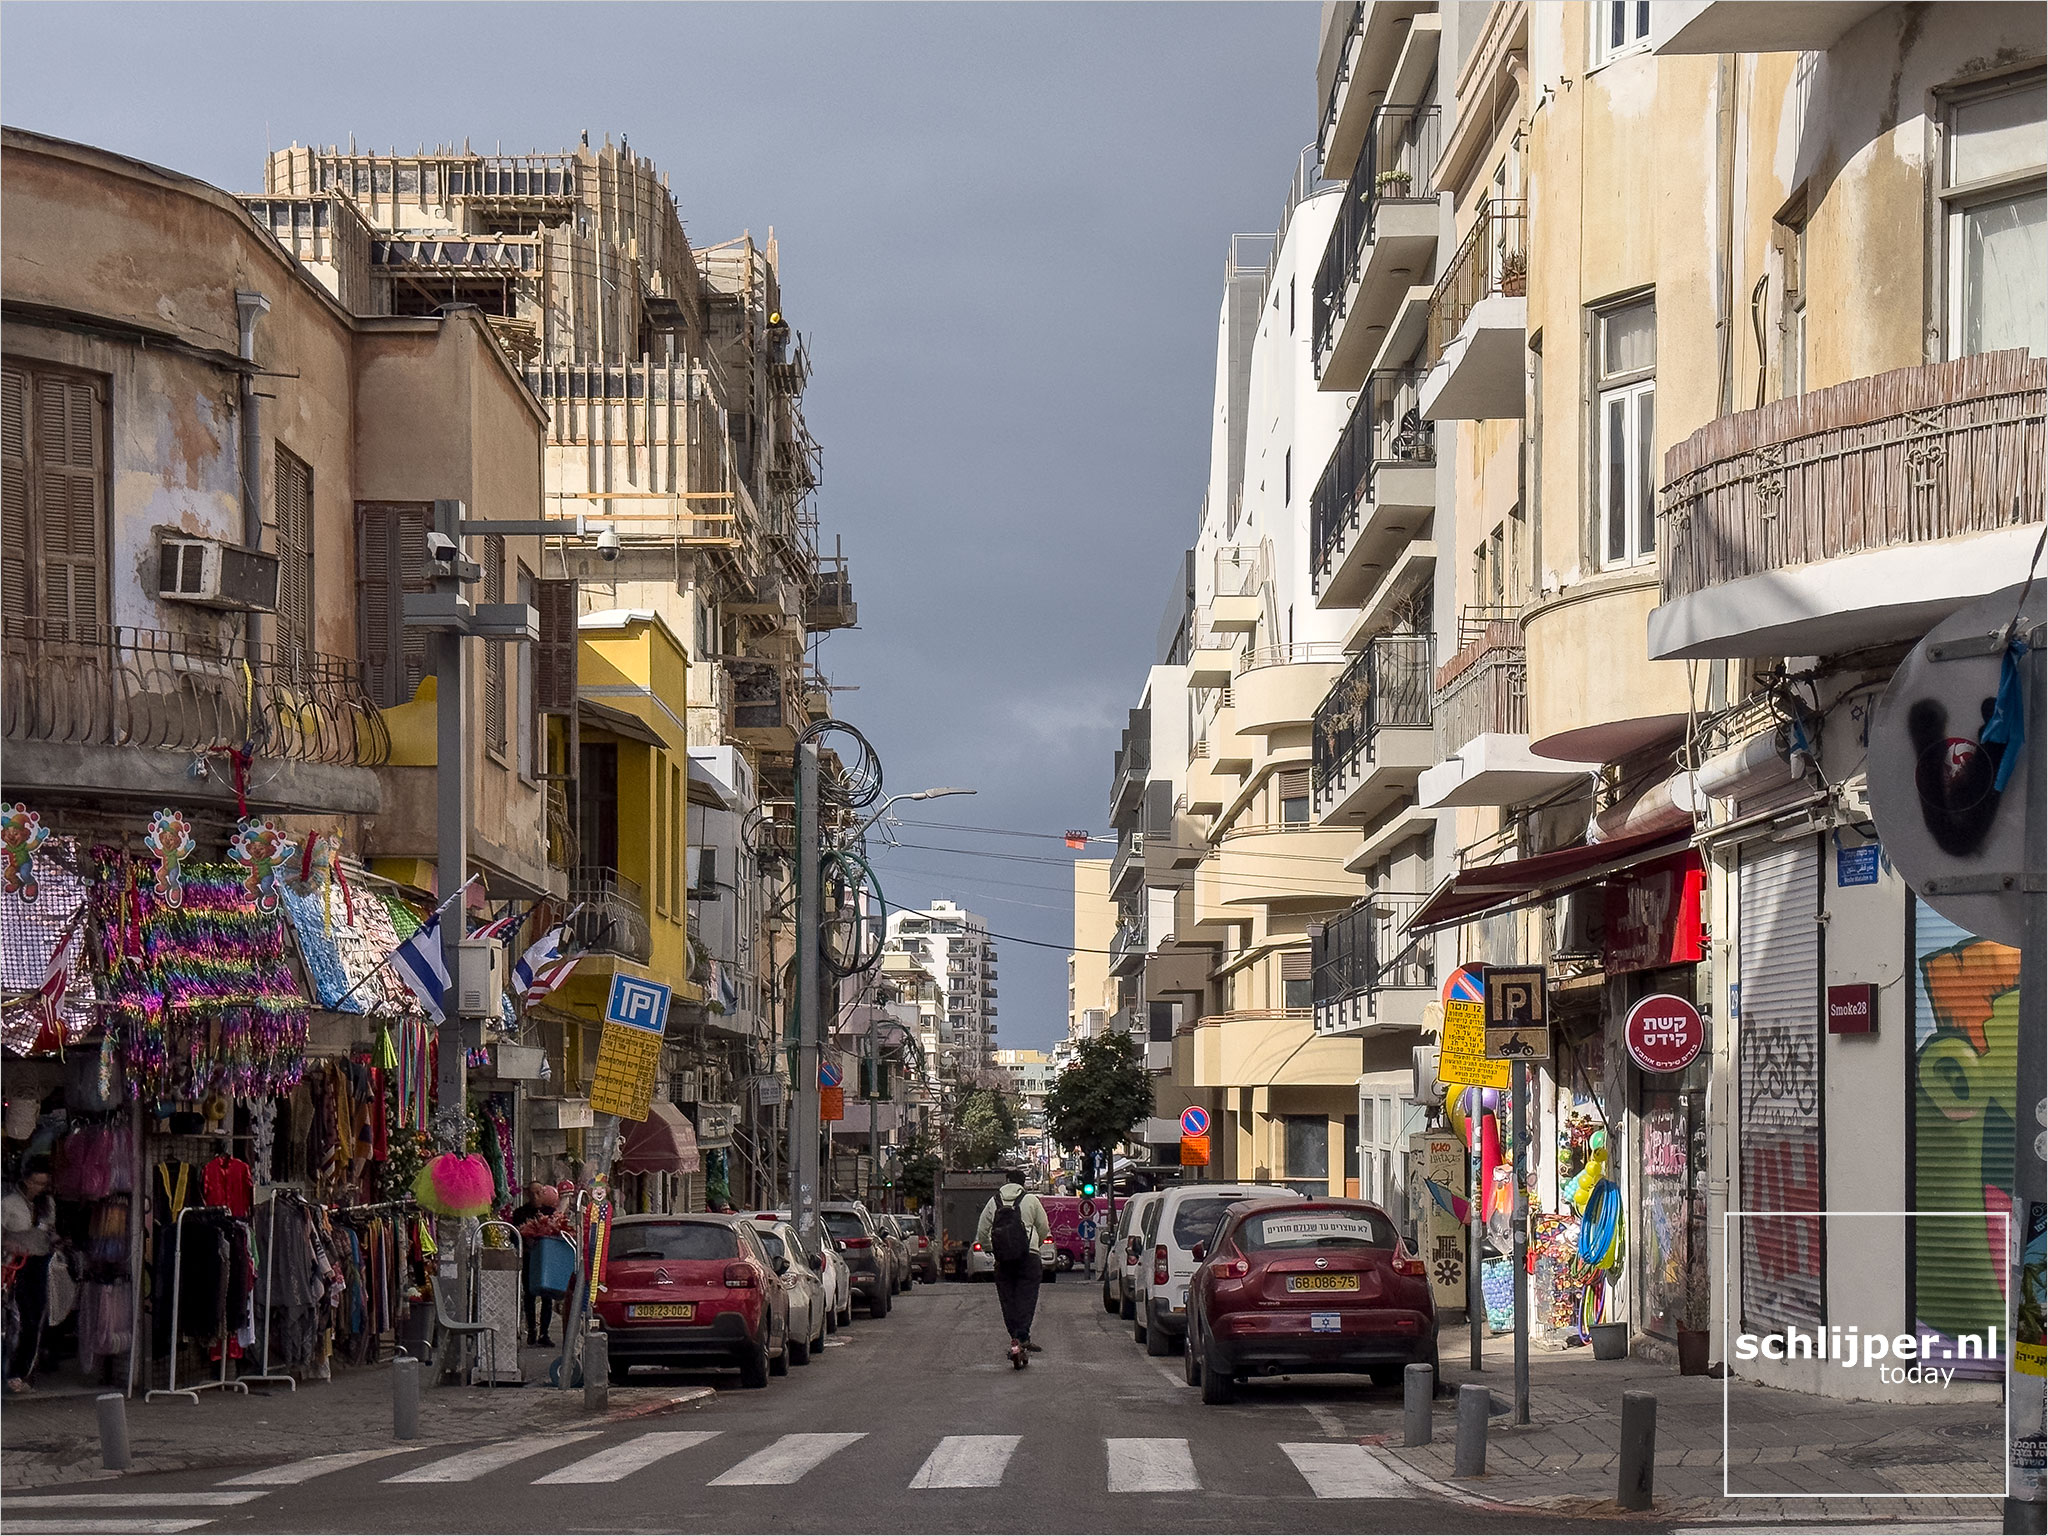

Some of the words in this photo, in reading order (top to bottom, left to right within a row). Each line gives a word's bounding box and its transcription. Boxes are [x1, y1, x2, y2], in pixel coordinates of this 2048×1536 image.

[1450, 1002, 1468, 1011] מטר
[1473, 1005, 1482, 1013] 12
[1830, 1001, 1867, 1017] Smoke28
[1643, 1016, 1687, 1033] קשת
[1643, 1033, 1688, 1048] קידס
[1681, 1044, 1698, 1062] בגדים
[1267, 1224, 1292, 1234] חוזרים
[1293, 1223, 1318, 1232] שכולם
[1319, 1223, 1329, 1231] עד
[1331, 1223, 1357, 1232] עוצרים
[1357, 1224, 1368, 1233] לא
